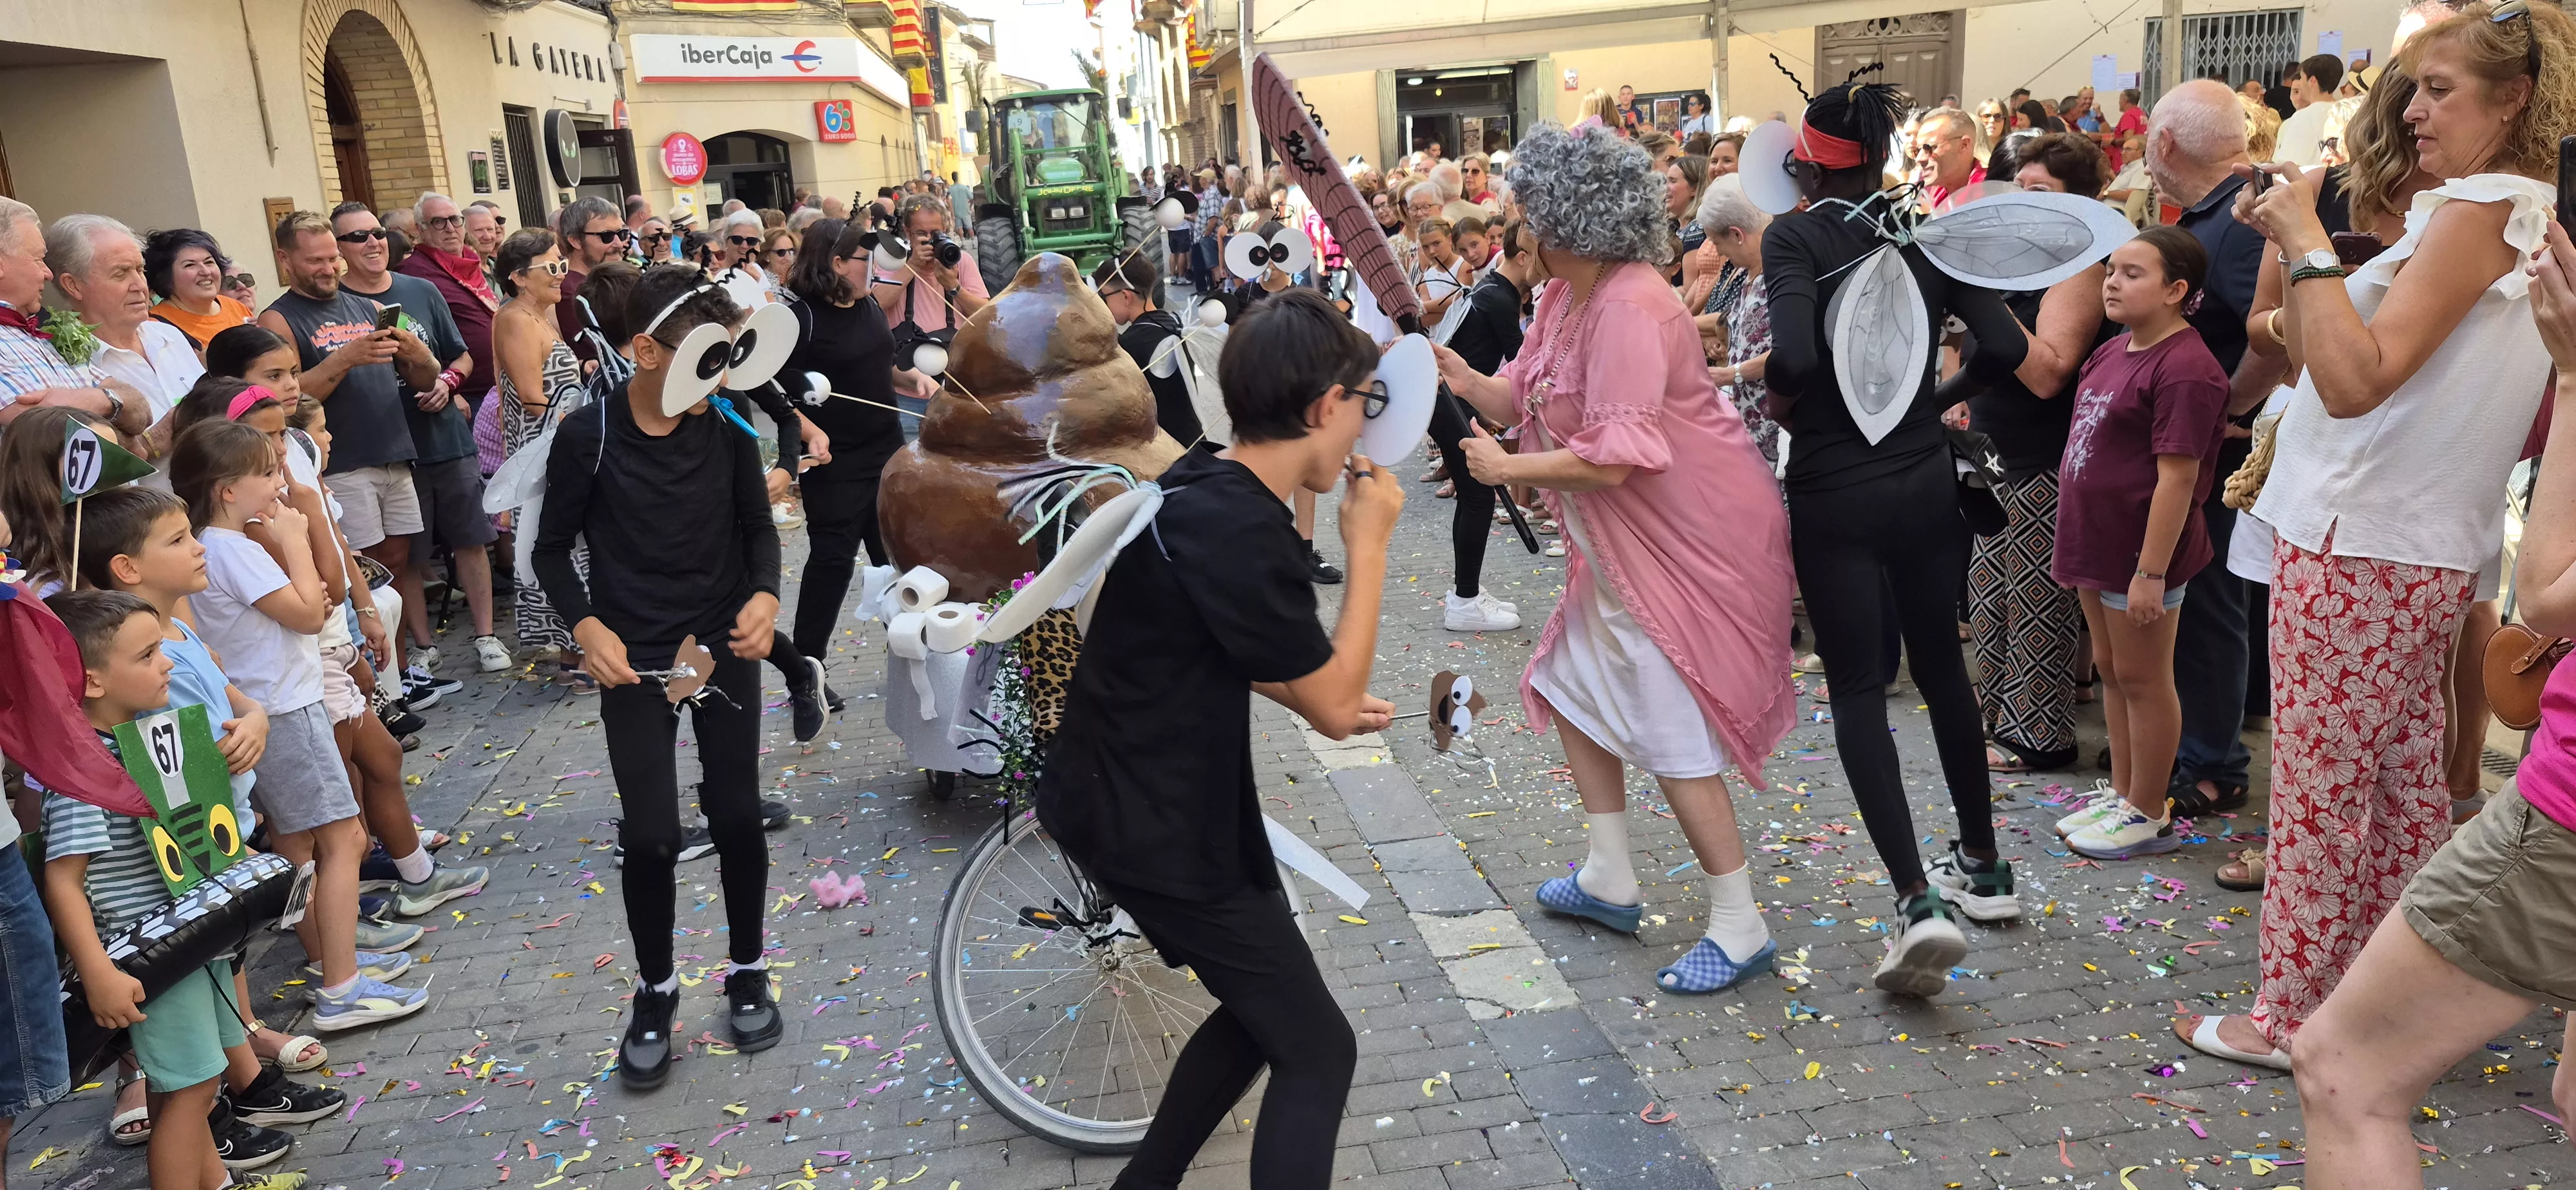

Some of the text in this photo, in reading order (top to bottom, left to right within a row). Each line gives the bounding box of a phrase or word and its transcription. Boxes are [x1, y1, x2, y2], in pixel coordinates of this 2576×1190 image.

[489, 32, 606, 83] LA GATERA
[680, 43, 773, 70] iberCaja
[672, 164, 699, 176] LOBAS
[1037, 187, 1063, 196] JOHN
[68, 438, 97, 490] 67
[151, 722, 179, 775] 67
